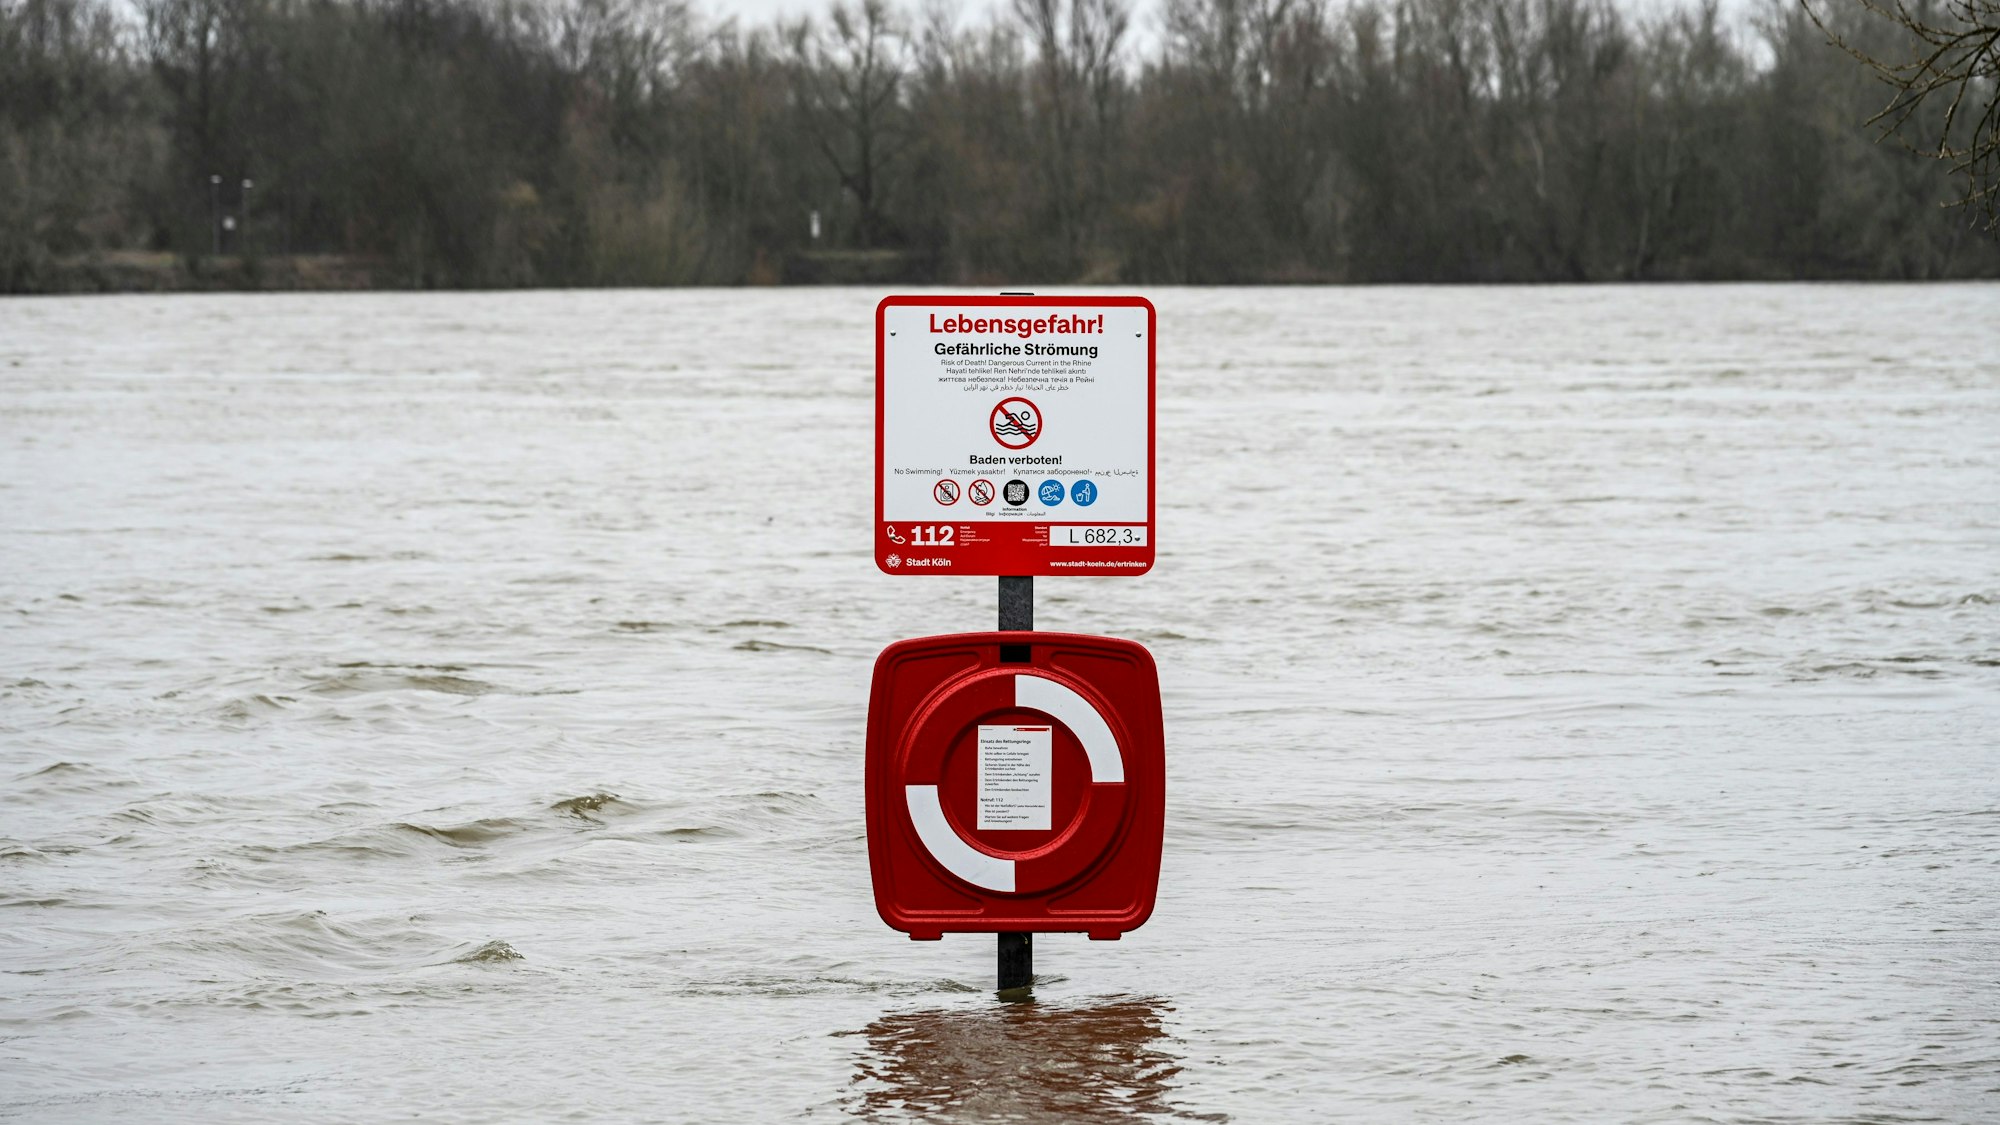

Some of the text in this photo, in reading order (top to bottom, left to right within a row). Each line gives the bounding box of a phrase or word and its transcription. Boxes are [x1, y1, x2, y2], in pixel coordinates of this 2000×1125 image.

[929, 313, 1104, 339] Lebensgefahr!
[934, 342, 1098, 359] Gefährliche Strömung
[988, 359, 1025, 368] Dangerous
[1025, 359, 1052, 367] Current
[1052, 359, 1059, 367] in
[1060, 359, 1071, 367] the
[1072, 359, 1092, 367] Rhine
[946, 367, 968, 376] Hayati
[968, 367, 993, 375] tehlike!
[993, 367, 1007, 375] Ren
[969, 454, 1063, 465] Baden verboten!
[905, 468, 943, 476] Swimming!
[911, 525, 954, 546] 112
[1069, 528, 1133, 546] L 682,3
[906, 558, 952, 567] Stadt Köln
[1049, 560, 1147, 569] www.stadt-koeln.de/ertrinken
